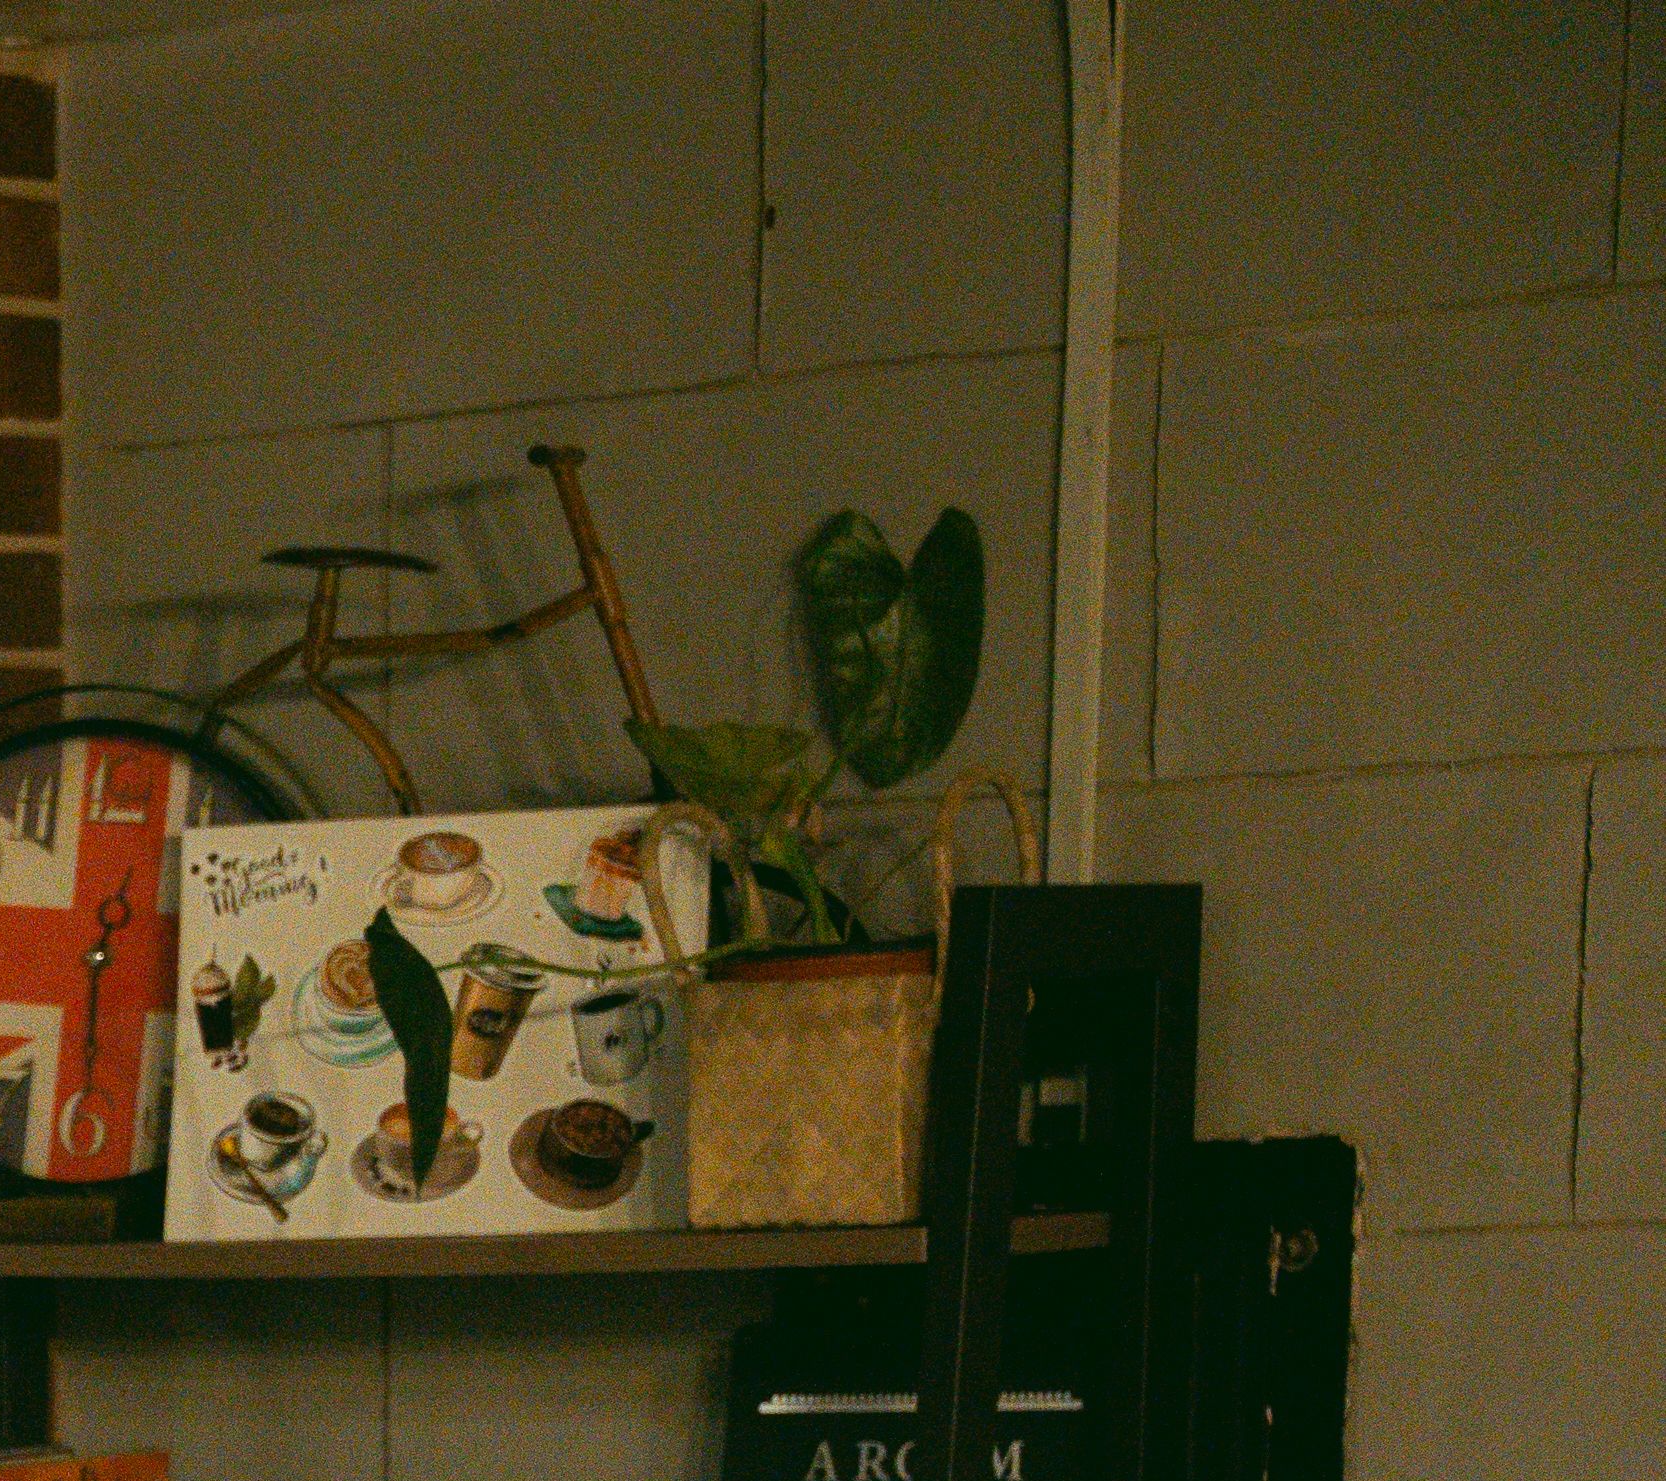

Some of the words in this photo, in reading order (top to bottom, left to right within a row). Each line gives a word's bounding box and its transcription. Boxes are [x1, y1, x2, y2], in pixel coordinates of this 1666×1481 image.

[13, 775, 55, 853] 11
[87, 755, 154, 824] 12
[57, 1088, 107, 1158] 6
